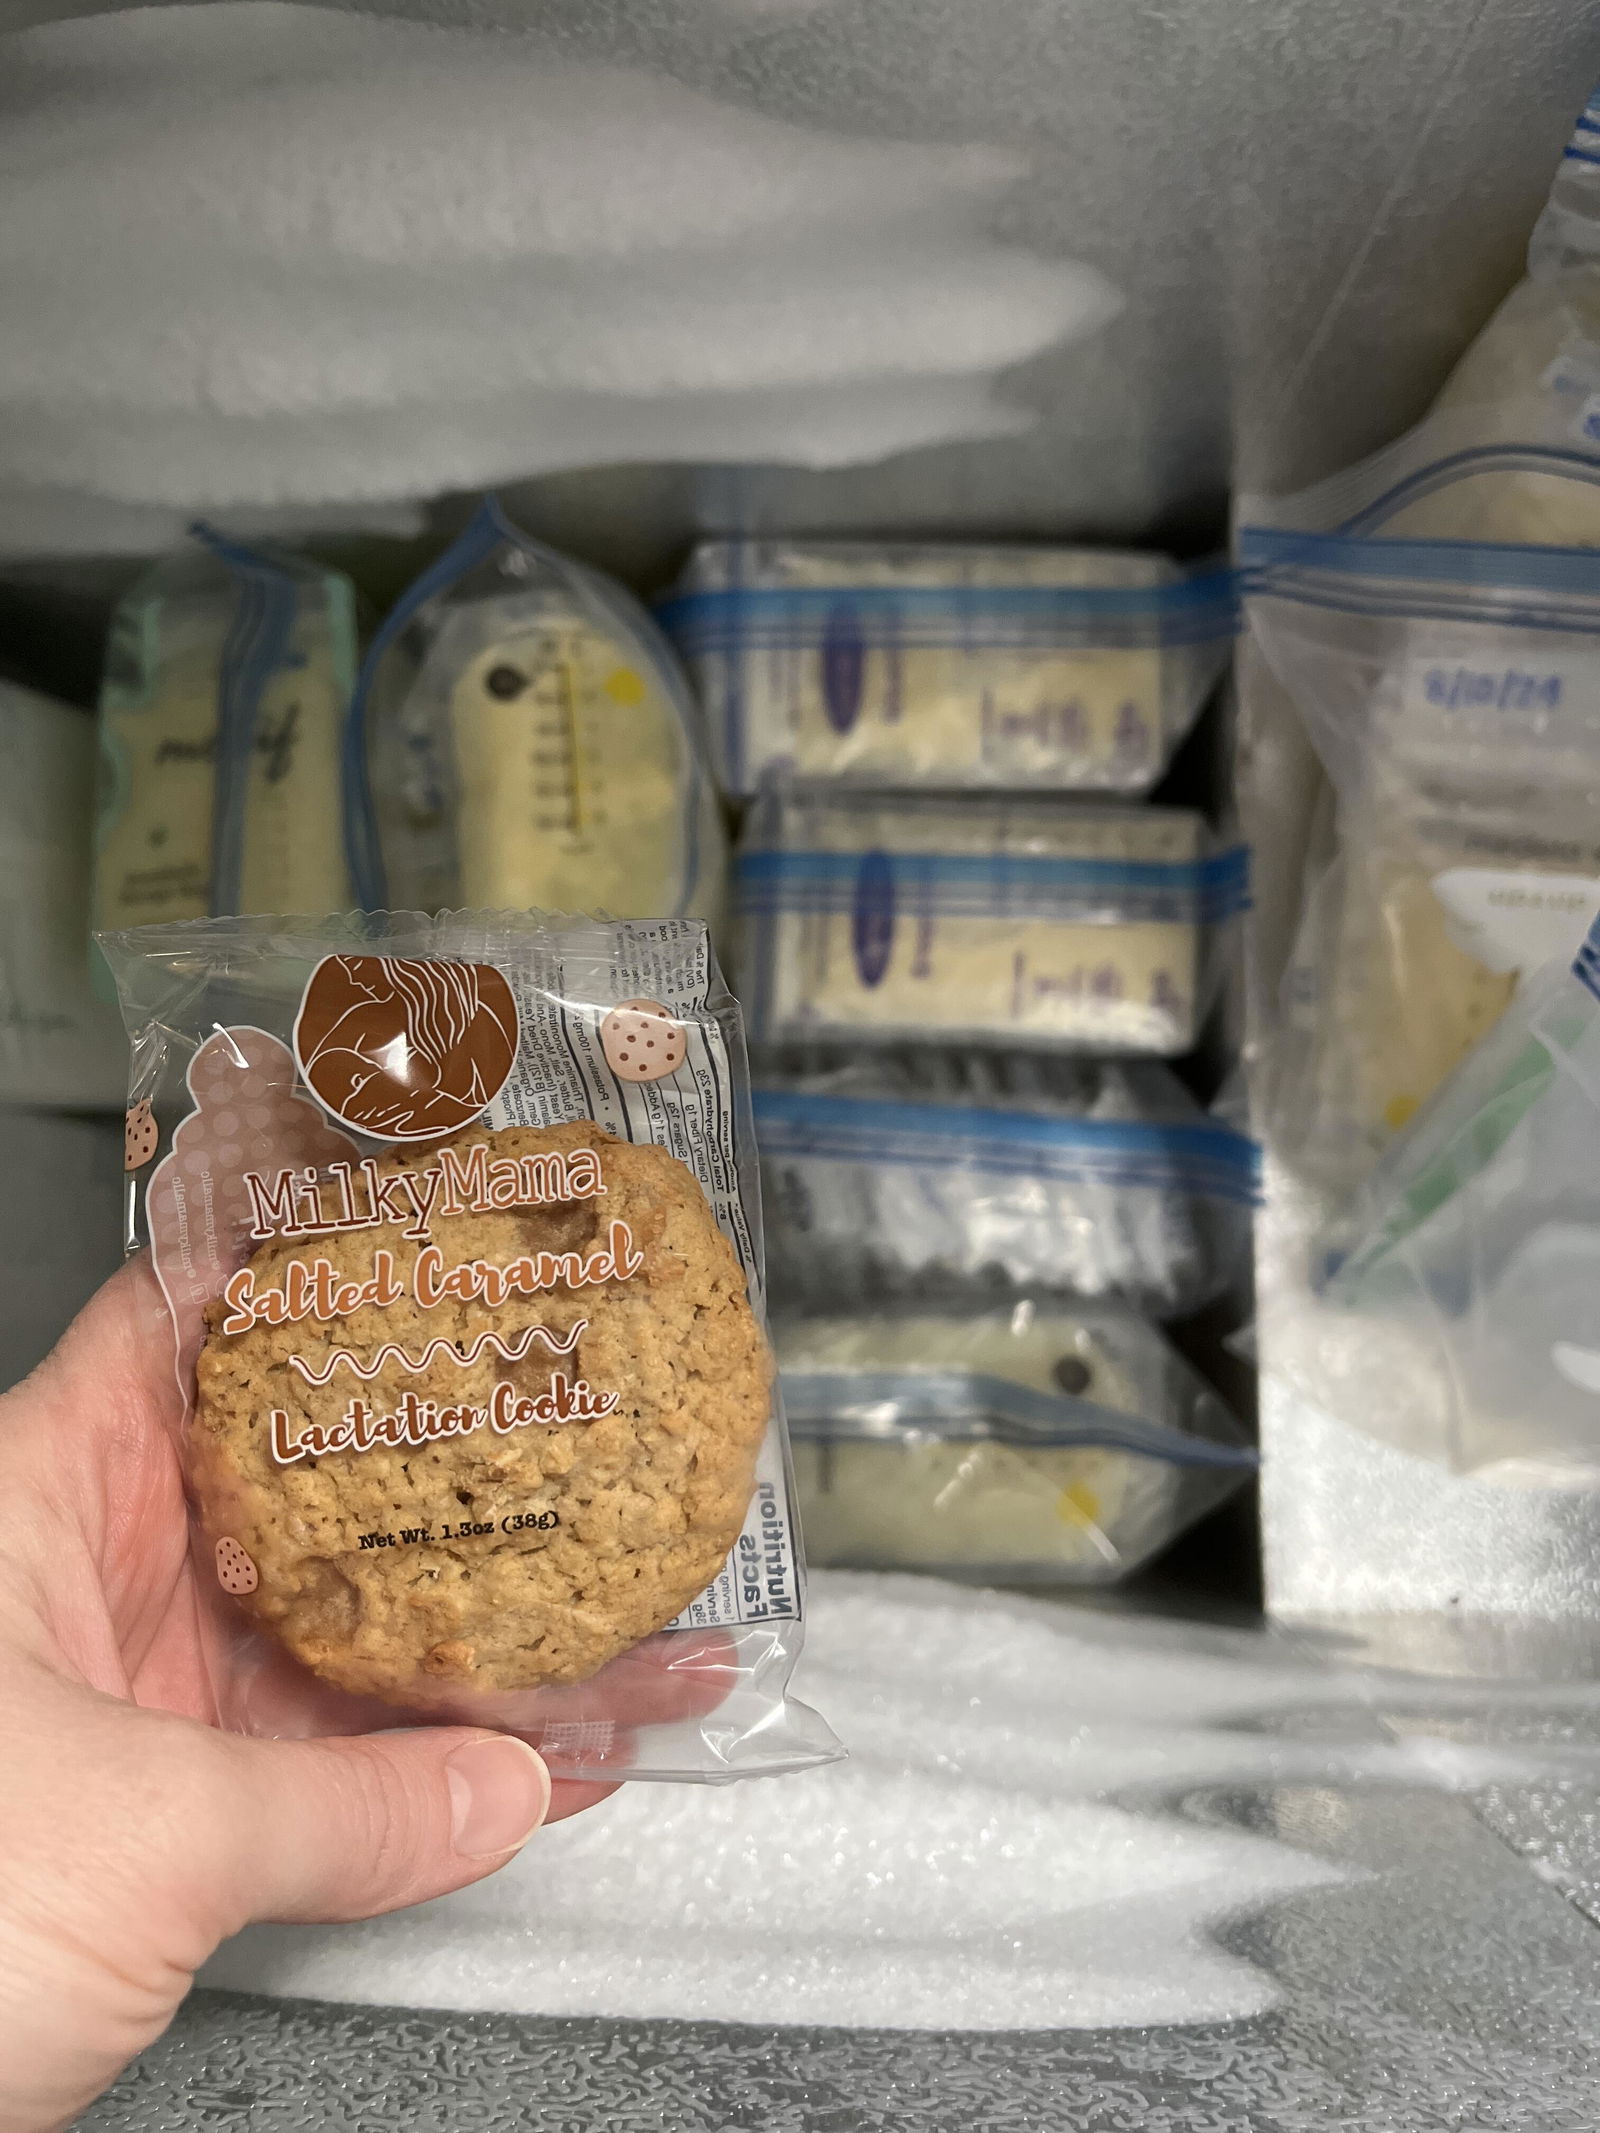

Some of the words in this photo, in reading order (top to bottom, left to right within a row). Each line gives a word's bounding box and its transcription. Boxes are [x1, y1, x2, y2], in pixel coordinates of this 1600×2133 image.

[244, 1145, 607, 1239] MilkyMama
[223, 1250, 401, 1335] Salted
[413, 1220, 644, 1308] Caramel
[271, 1392, 488, 1464] Lactation
[489, 1373, 619, 1434] Cookie
[358, 1531, 396, 1550] Net
[399, 1526, 436, 1545] Wt.
[441, 1520, 495, 1540] 1.3oz
[501, 1510, 560, 1534] (38g)
